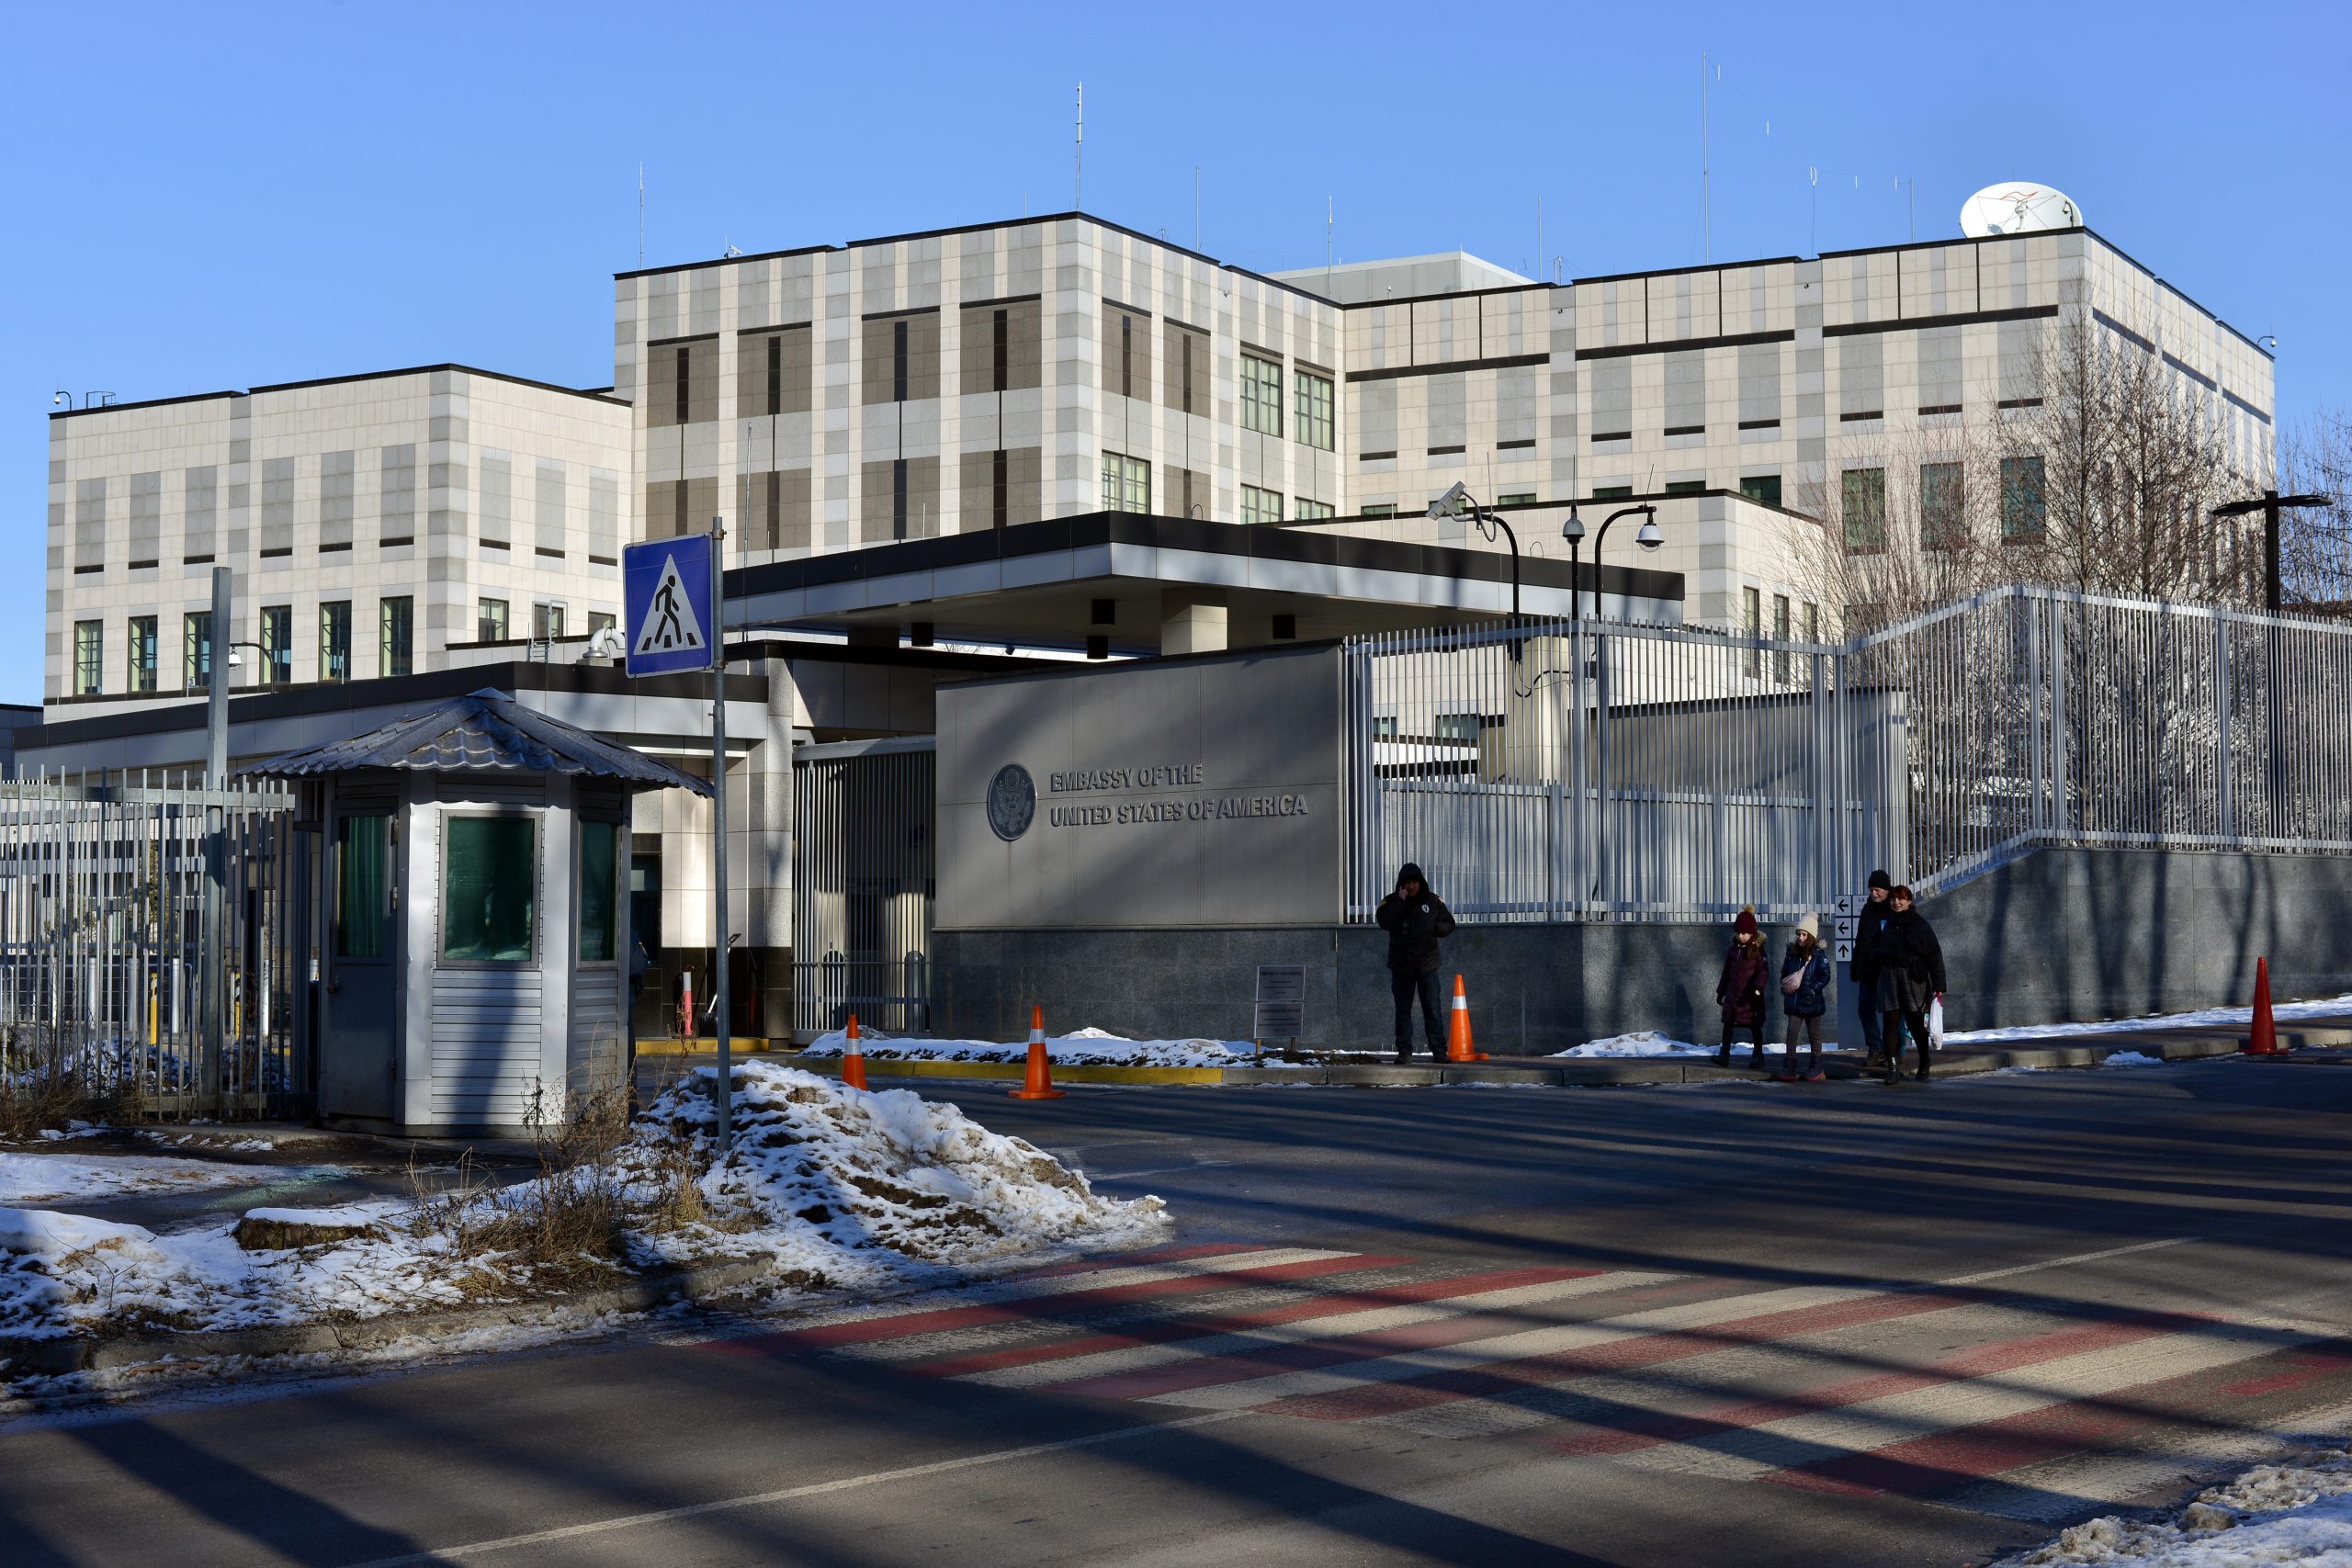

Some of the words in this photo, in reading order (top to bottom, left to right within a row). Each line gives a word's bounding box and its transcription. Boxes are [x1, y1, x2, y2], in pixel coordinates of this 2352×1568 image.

[1051, 767, 1136, 792] EMBASSY
[1138, 765, 1163, 787] OF
[1166, 763, 1203, 785] THE
[1051, 804, 1114, 827] UNITED
[1117, 800, 1186, 824] STATES
[1188, 798, 1215, 820] OF
[1216, 794, 1308, 819] AMERICA
